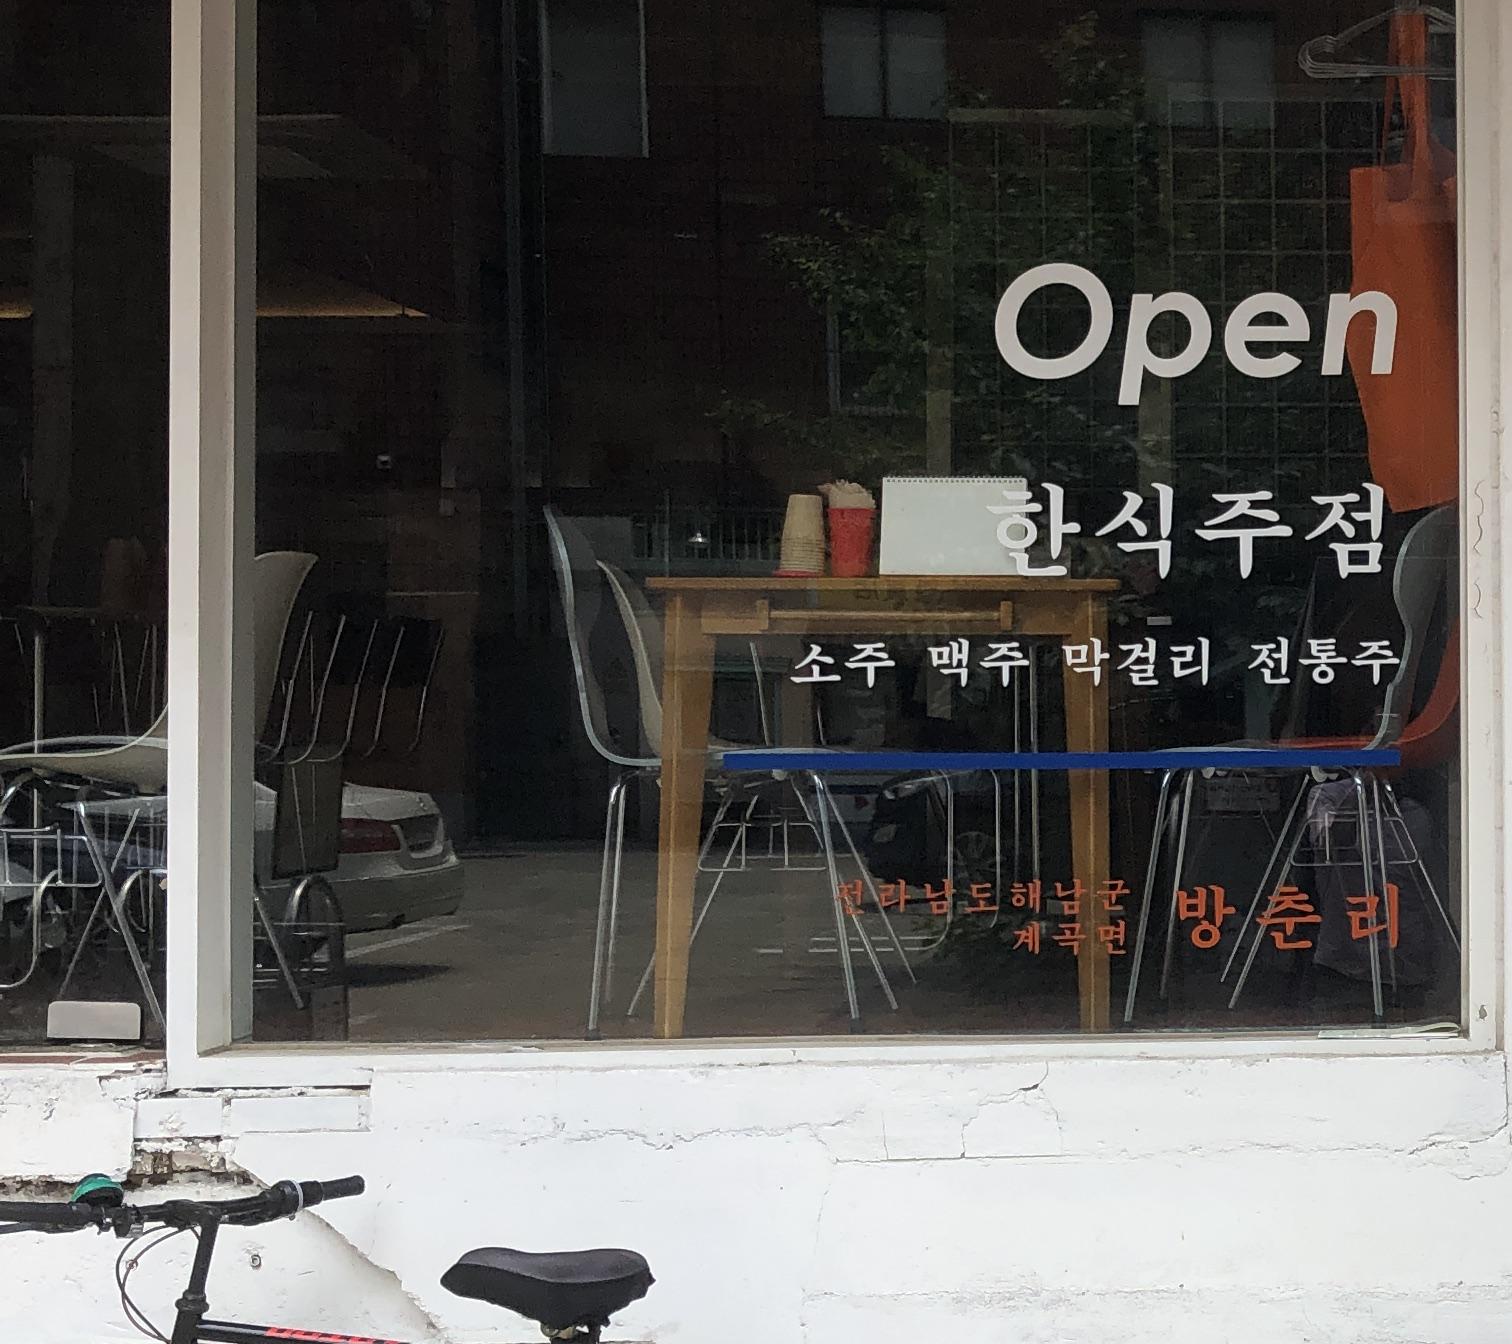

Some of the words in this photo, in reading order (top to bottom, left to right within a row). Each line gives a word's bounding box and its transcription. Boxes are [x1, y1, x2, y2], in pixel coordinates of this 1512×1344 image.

[994, 262, 1398, 406] Open
[986, 482, 1385, 580] 한식주점
[789, 641, 896, 689] 소주
[926, 637, 1030, 688] 맥주
[1061, 636, 1210, 687] 막걸리
[1247, 636, 1401, 686] 전통주
[1012, 919, 1127, 955] 계곡면
[1176, 883, 1399, 950] 방춘리
